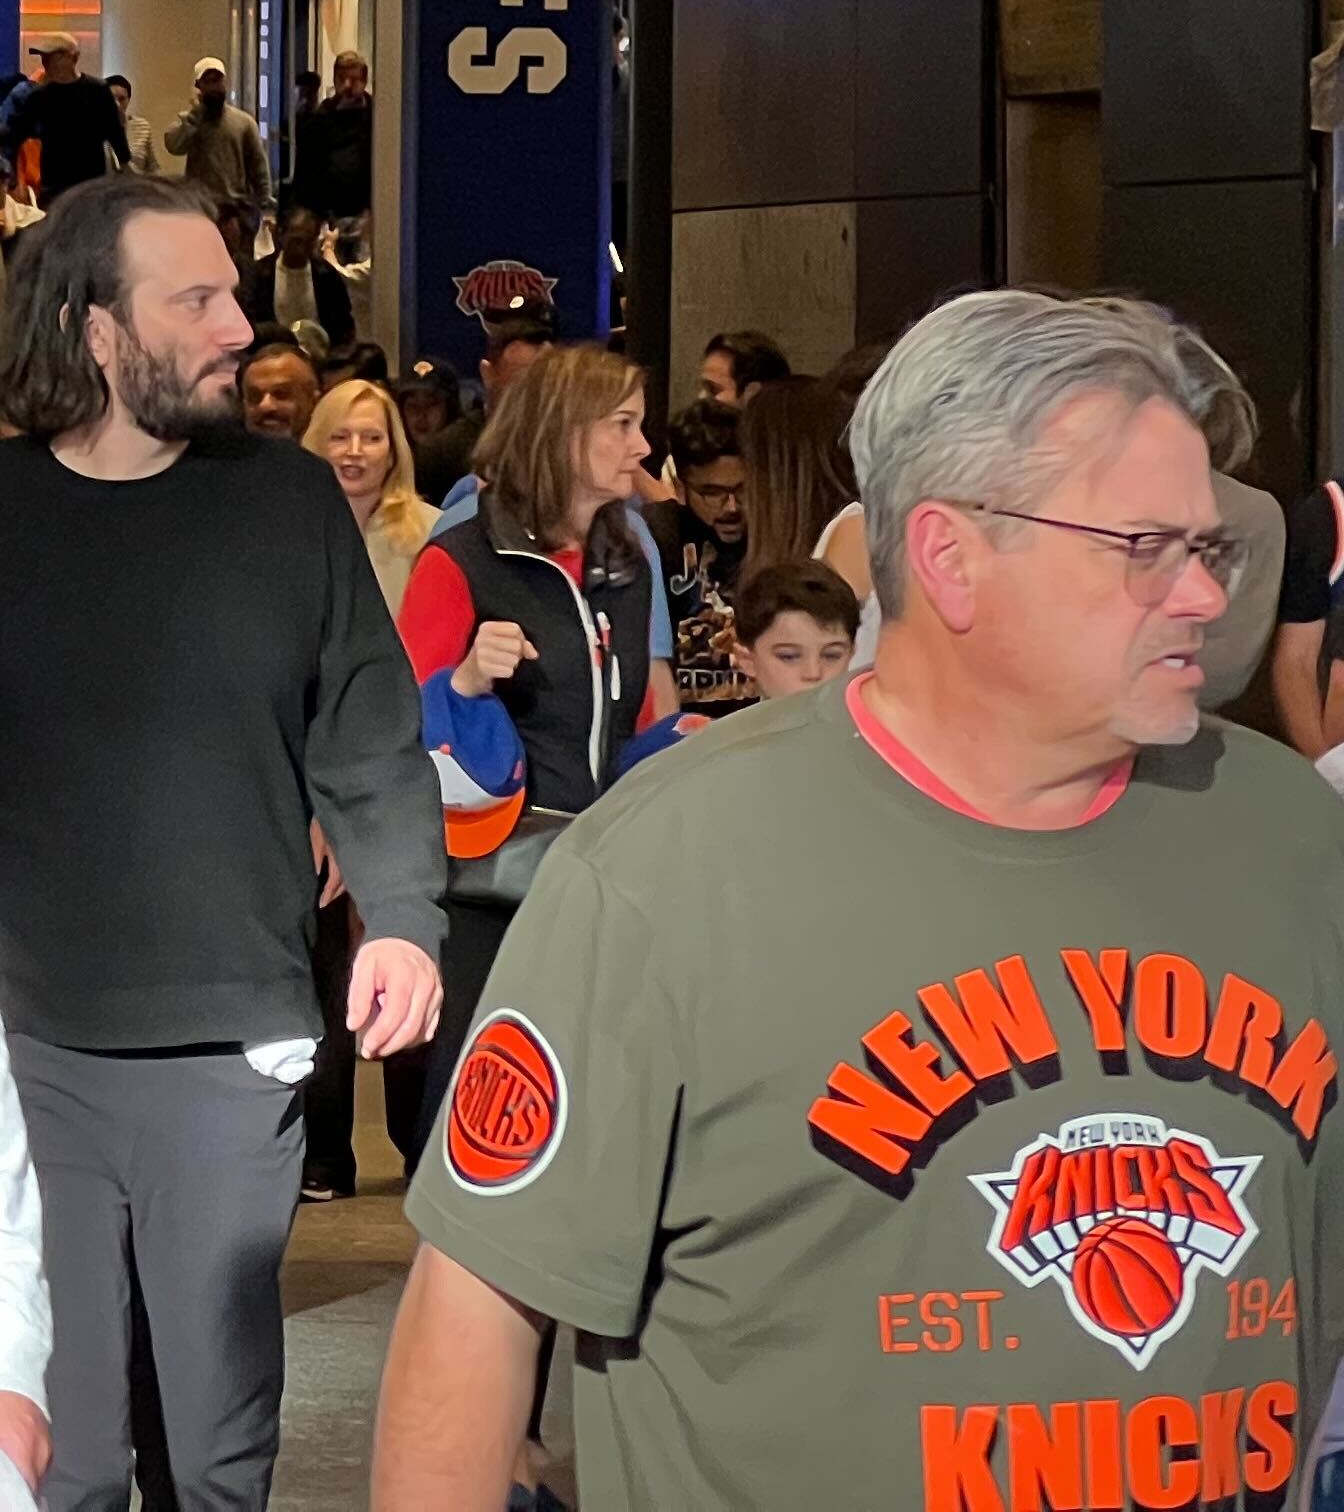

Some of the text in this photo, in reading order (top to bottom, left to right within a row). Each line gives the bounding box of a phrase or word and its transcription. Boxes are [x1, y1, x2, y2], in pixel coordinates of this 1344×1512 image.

[807, 947, 1340, 1196] NEW YORK
[1065, 1121, 1162, 1148] NEW YORK
[1000, 1139, 1246, 1254] KNICKS
[878, 1277, 1298, 1355] EST. 194
[919, 1380, 1300, 1512] KNICKS
